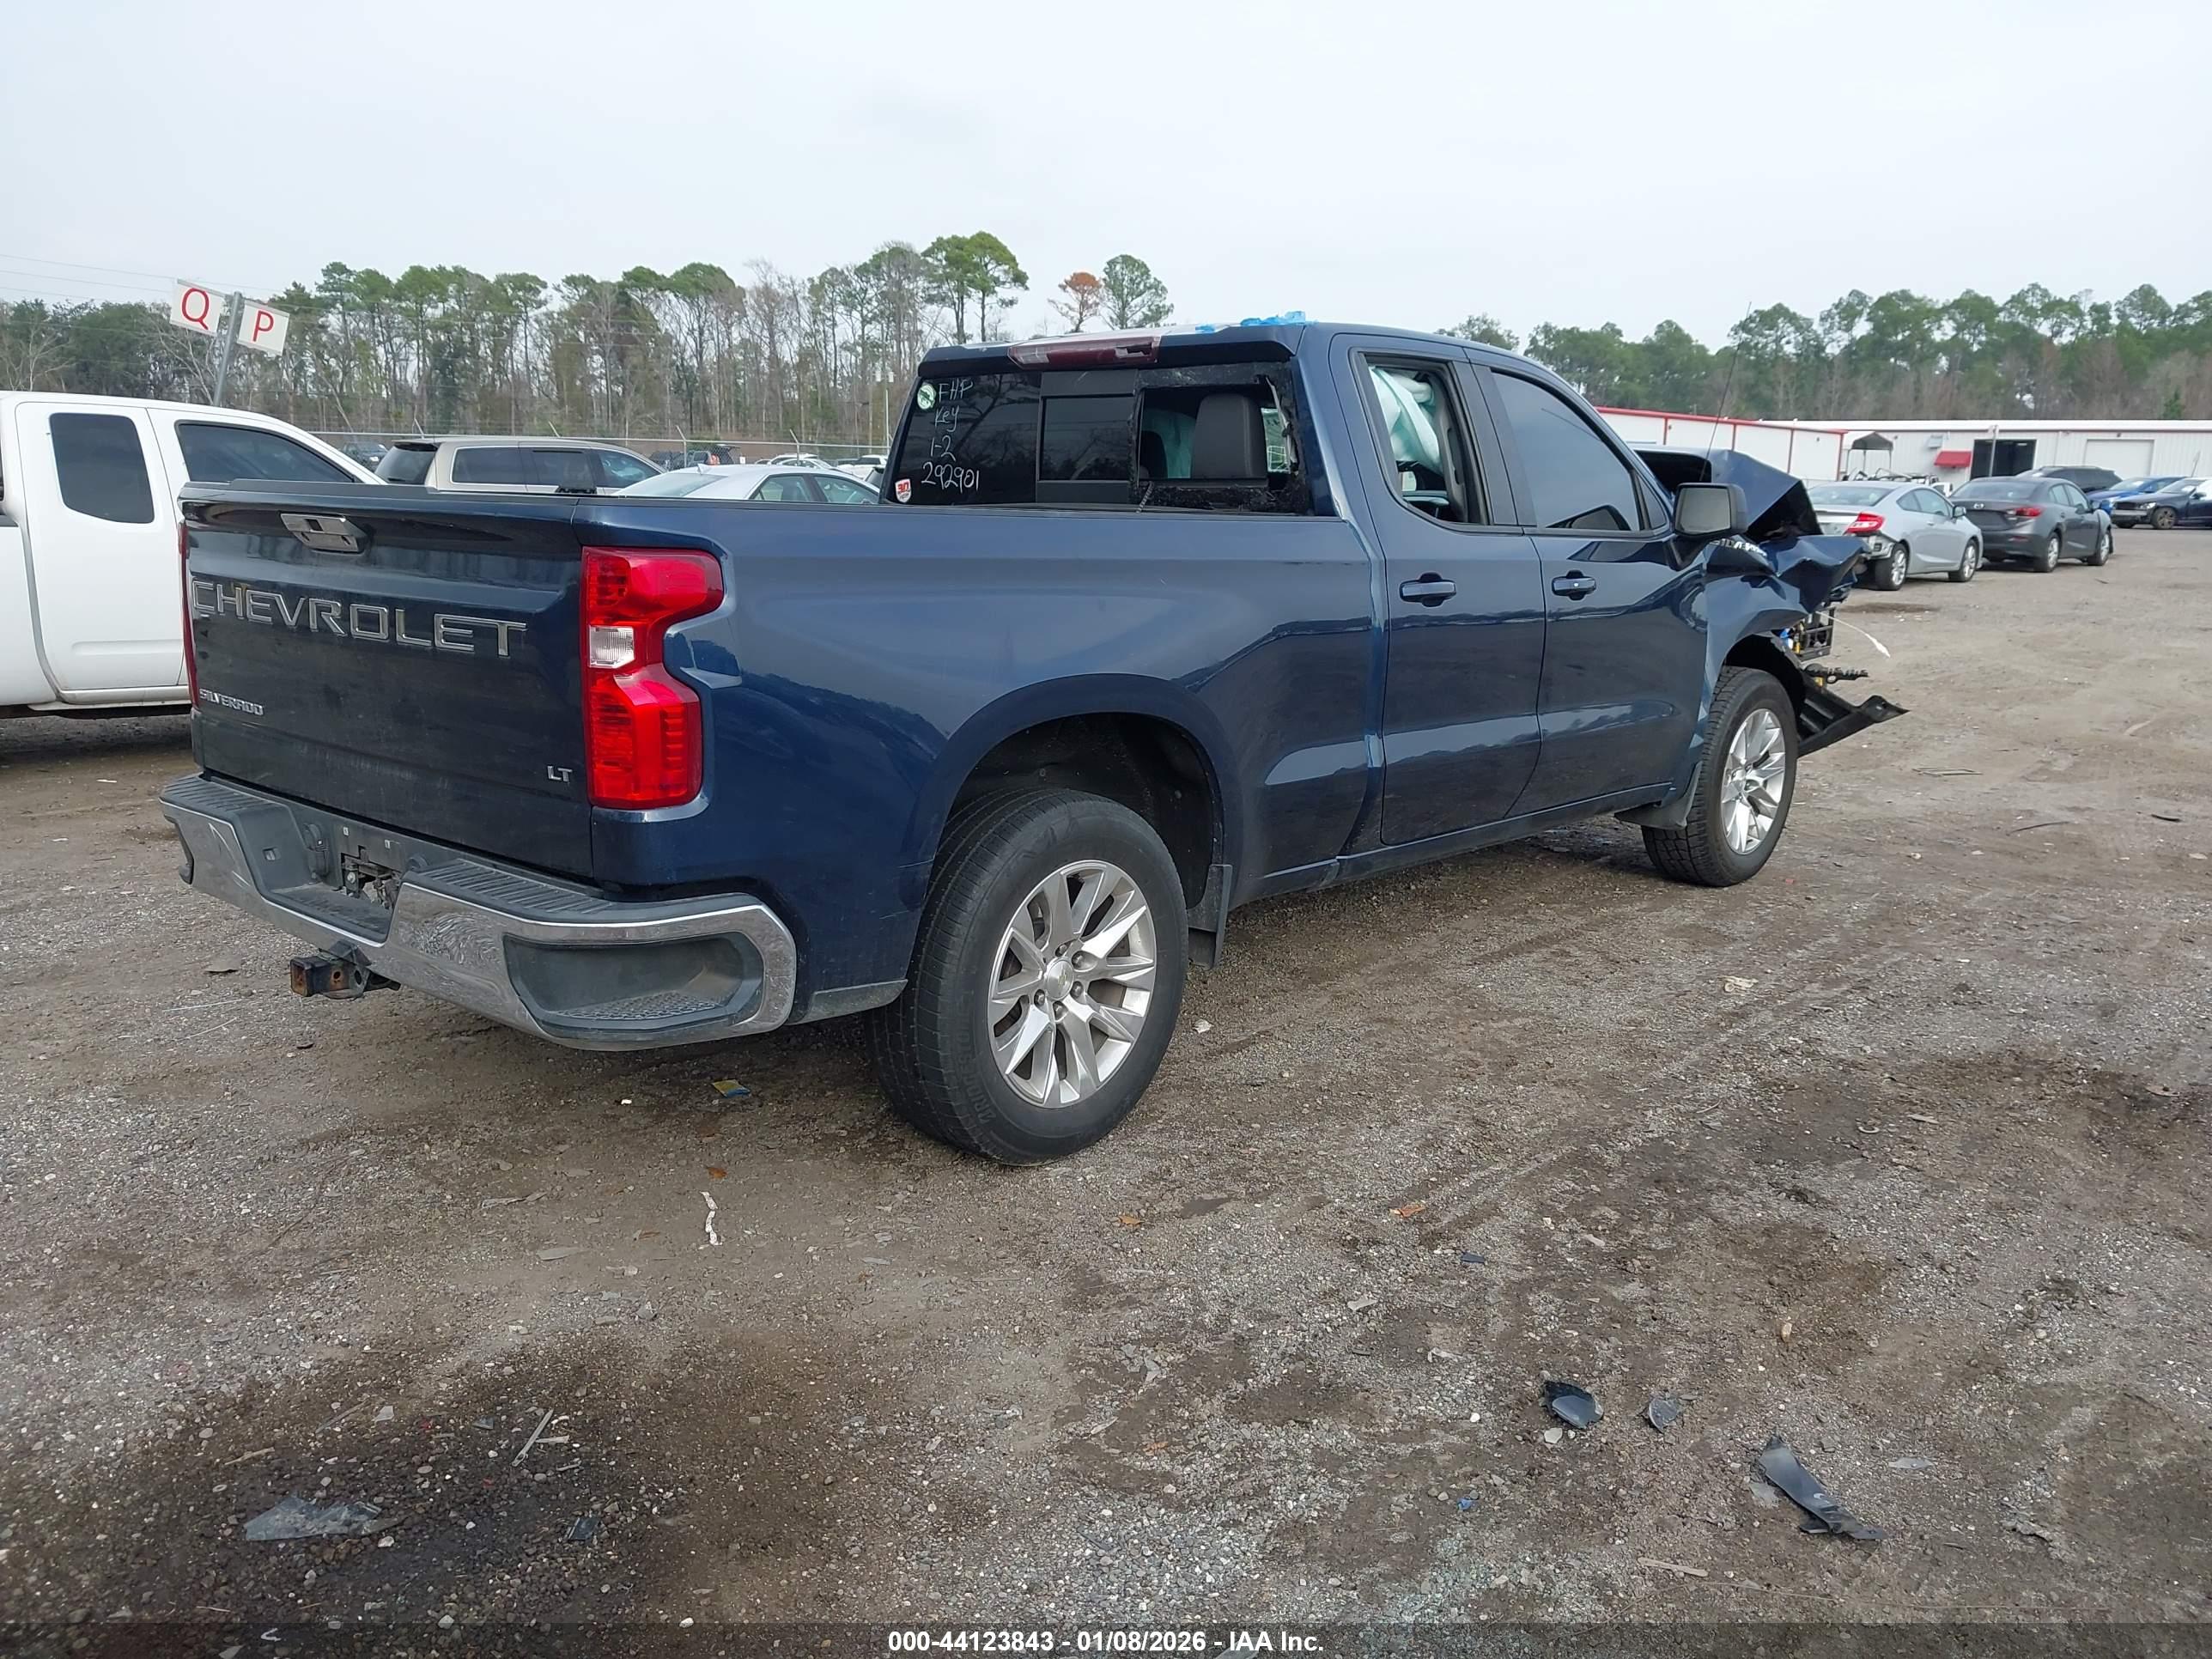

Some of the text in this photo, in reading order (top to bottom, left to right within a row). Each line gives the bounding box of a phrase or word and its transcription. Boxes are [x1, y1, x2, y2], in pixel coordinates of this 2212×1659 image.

[182, 288, 210, 331] Q
[252, 310, 274, 343] P
[921, 461, 980, 494] 292901
[191, 580, 527, 659] CHEVROLET
[199, 688, 264, 716] SILVERADO
[547, 764, 573, 783] LT
